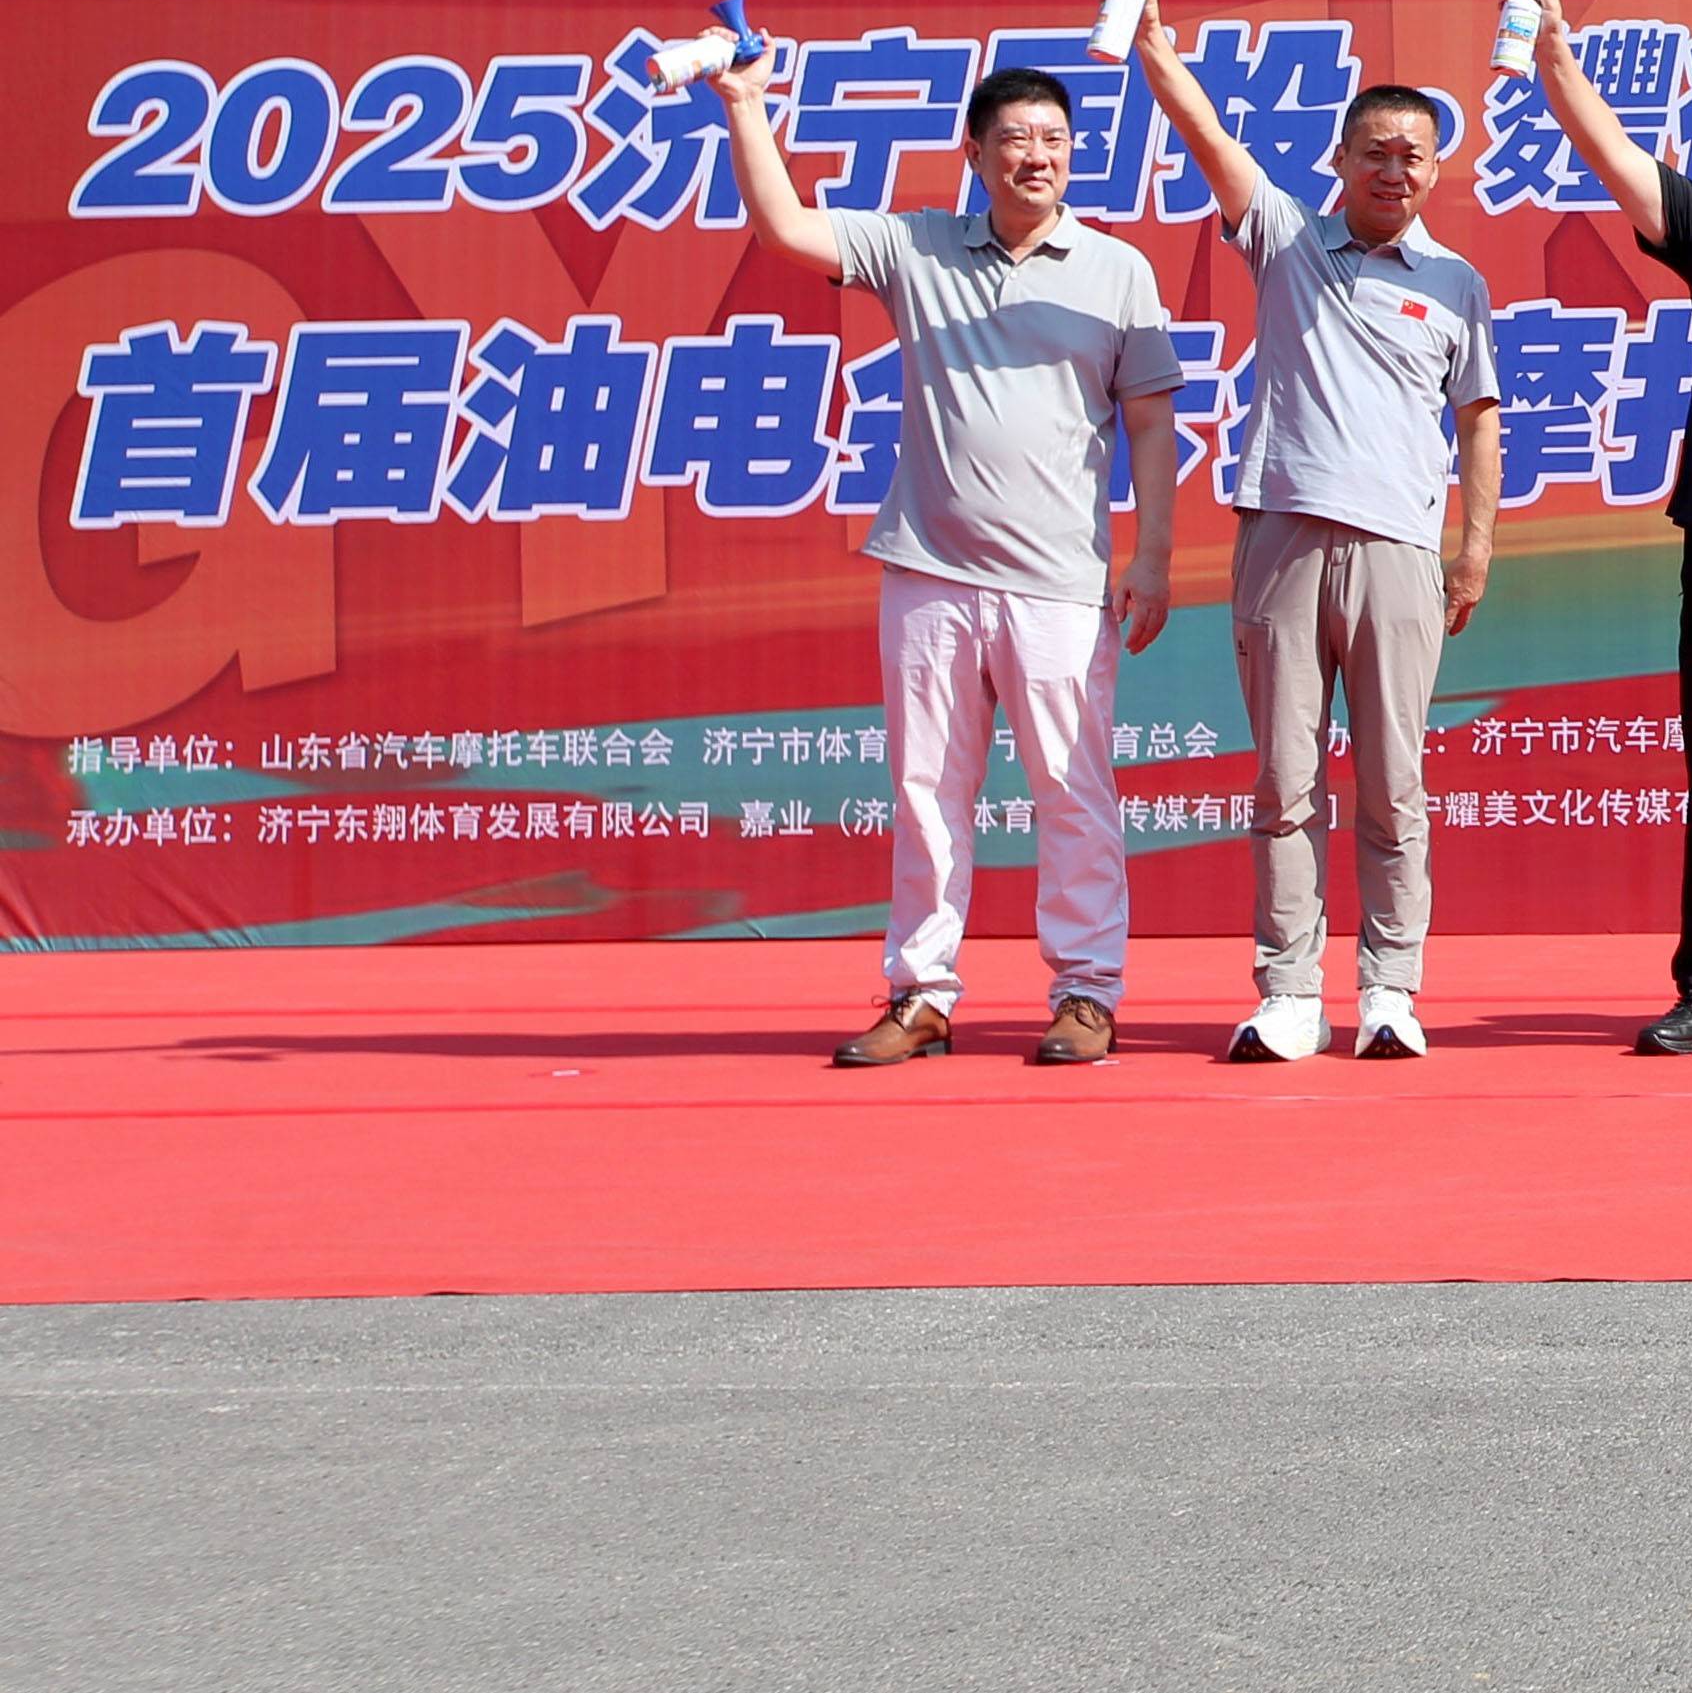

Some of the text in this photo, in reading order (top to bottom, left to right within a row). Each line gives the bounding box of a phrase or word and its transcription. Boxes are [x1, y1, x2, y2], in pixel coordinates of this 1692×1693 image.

[66, 800, 710, 847] 承办单位：济宁东翔体育发展有限公司
